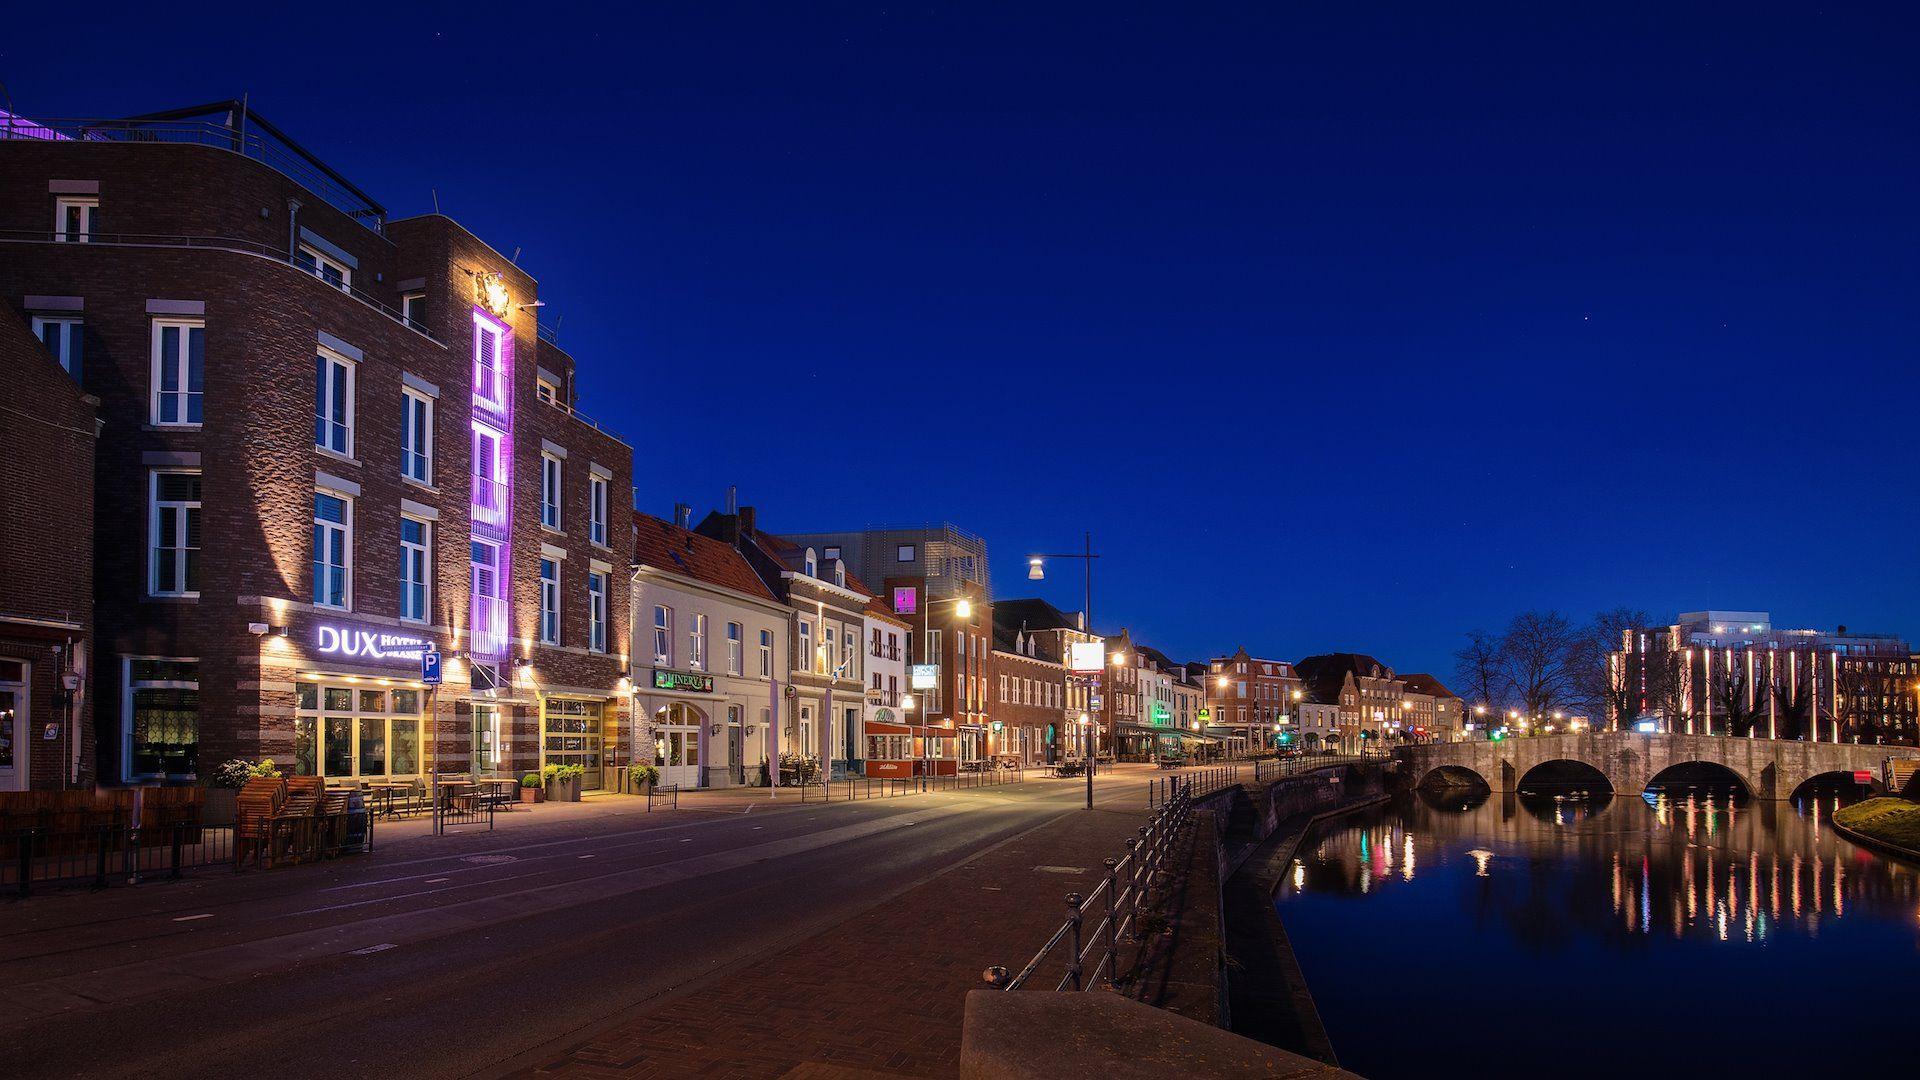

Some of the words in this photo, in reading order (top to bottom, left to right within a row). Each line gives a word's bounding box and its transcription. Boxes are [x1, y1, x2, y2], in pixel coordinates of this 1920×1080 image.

[318, 626, 386, 658] DUX
[425, 654, 437, 671] P
[666, 672, 704, 689] MINERVA
